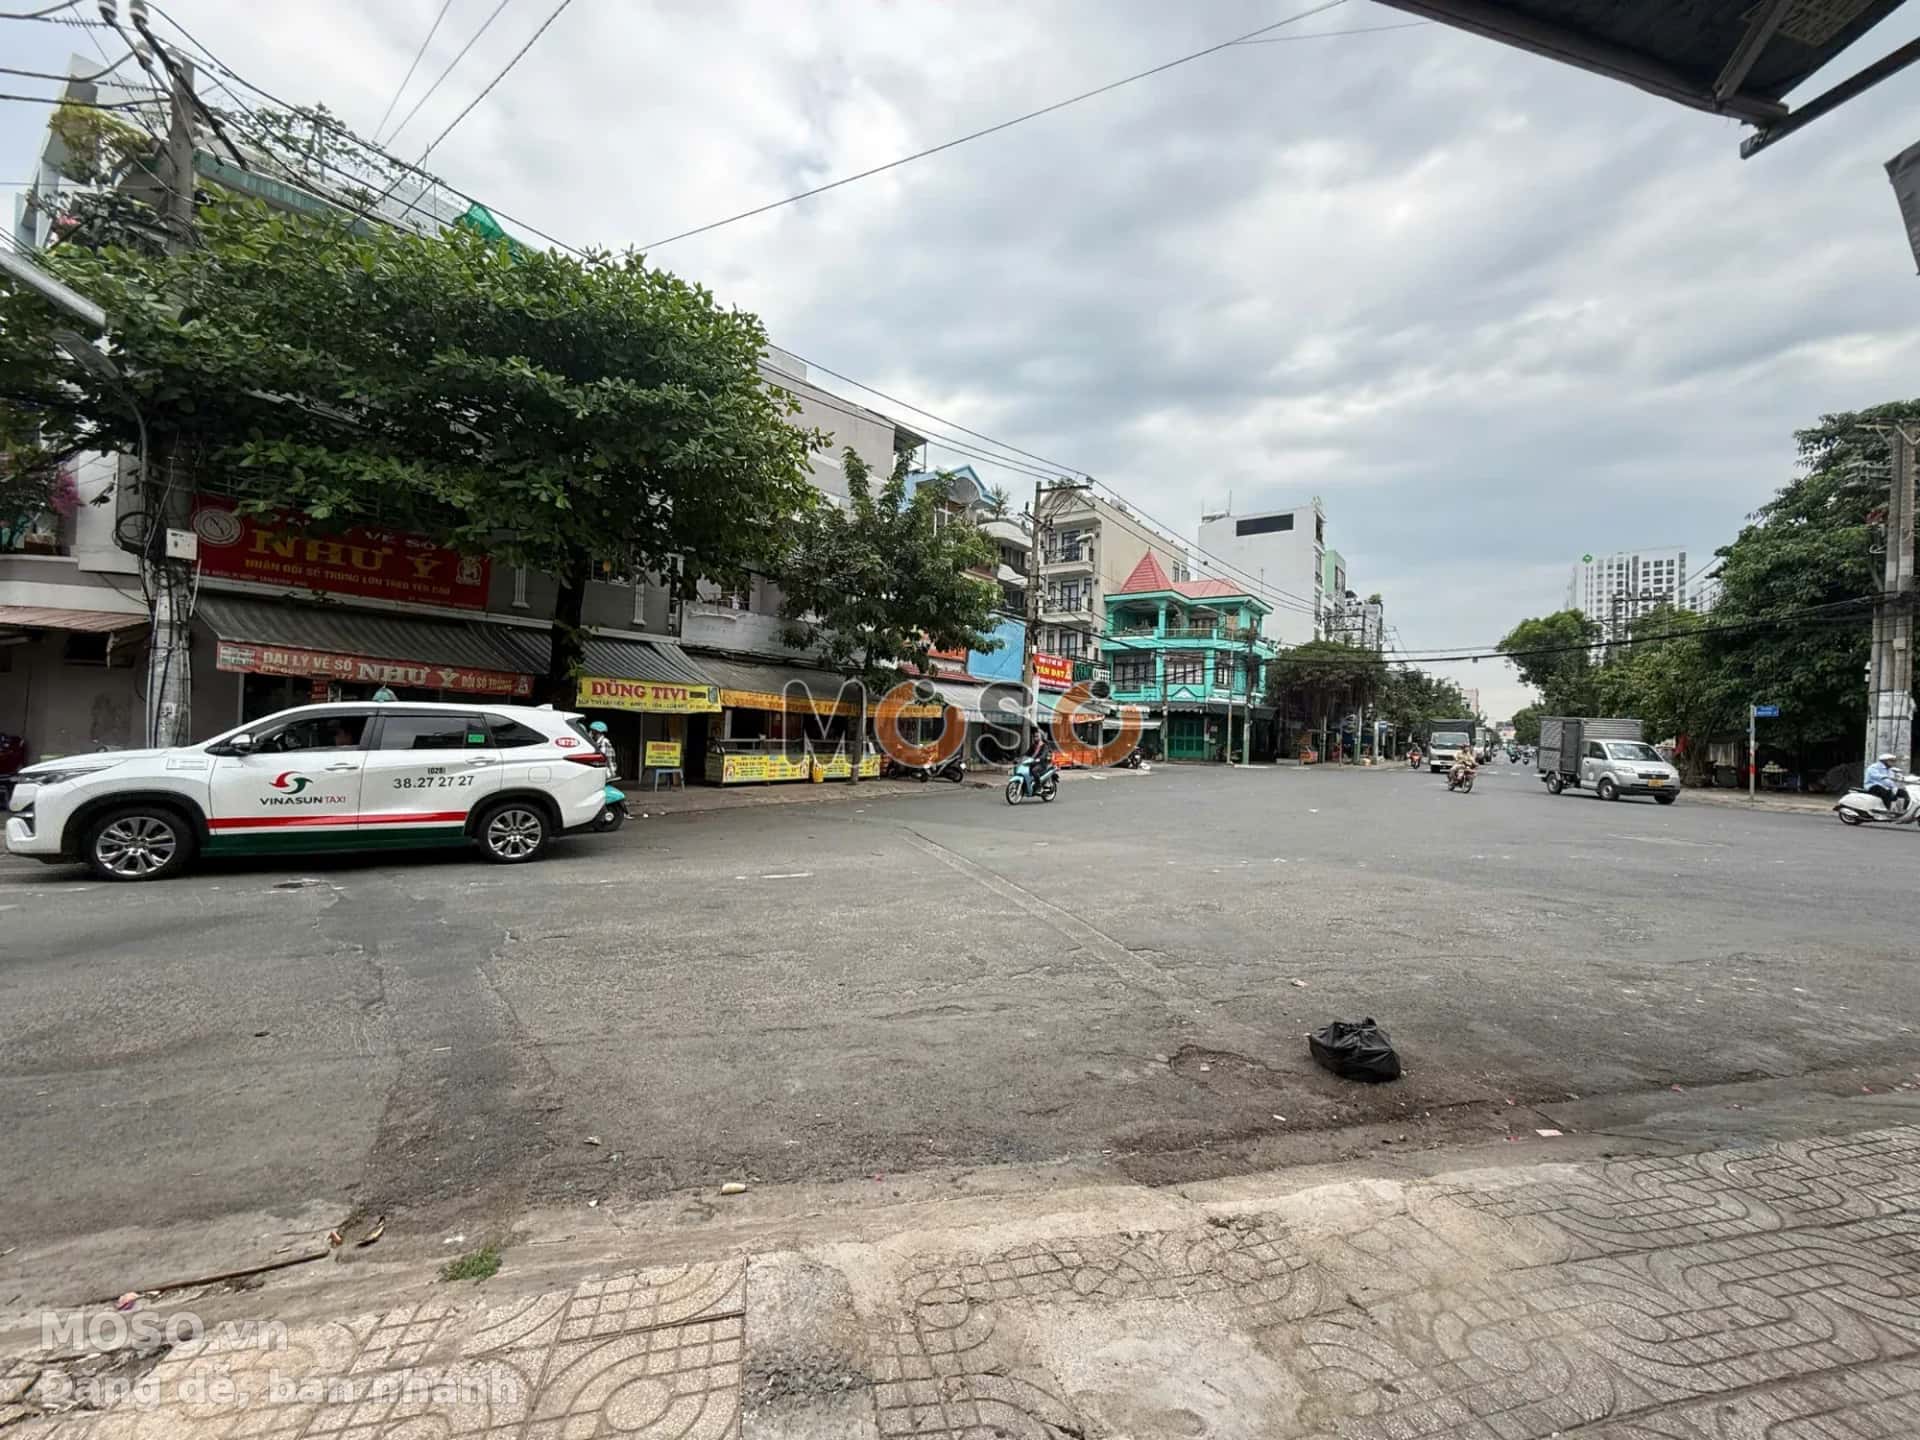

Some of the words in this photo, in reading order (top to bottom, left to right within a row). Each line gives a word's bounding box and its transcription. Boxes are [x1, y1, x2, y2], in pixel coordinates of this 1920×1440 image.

[248, 529, 393, 571] NHƯ
[313, 655, 330, 669] VÉ
[334, 658, 354, 672] SỐ
[358, 662, 431, 686] NHƯ
[437, 667, 460, 689] Ý
[651, 686, 688, 701] TIVI
[393, 777, 434, 789] 38.27
[438, 776, 455, 788] 27
[458, 775, 475, 787] 27
